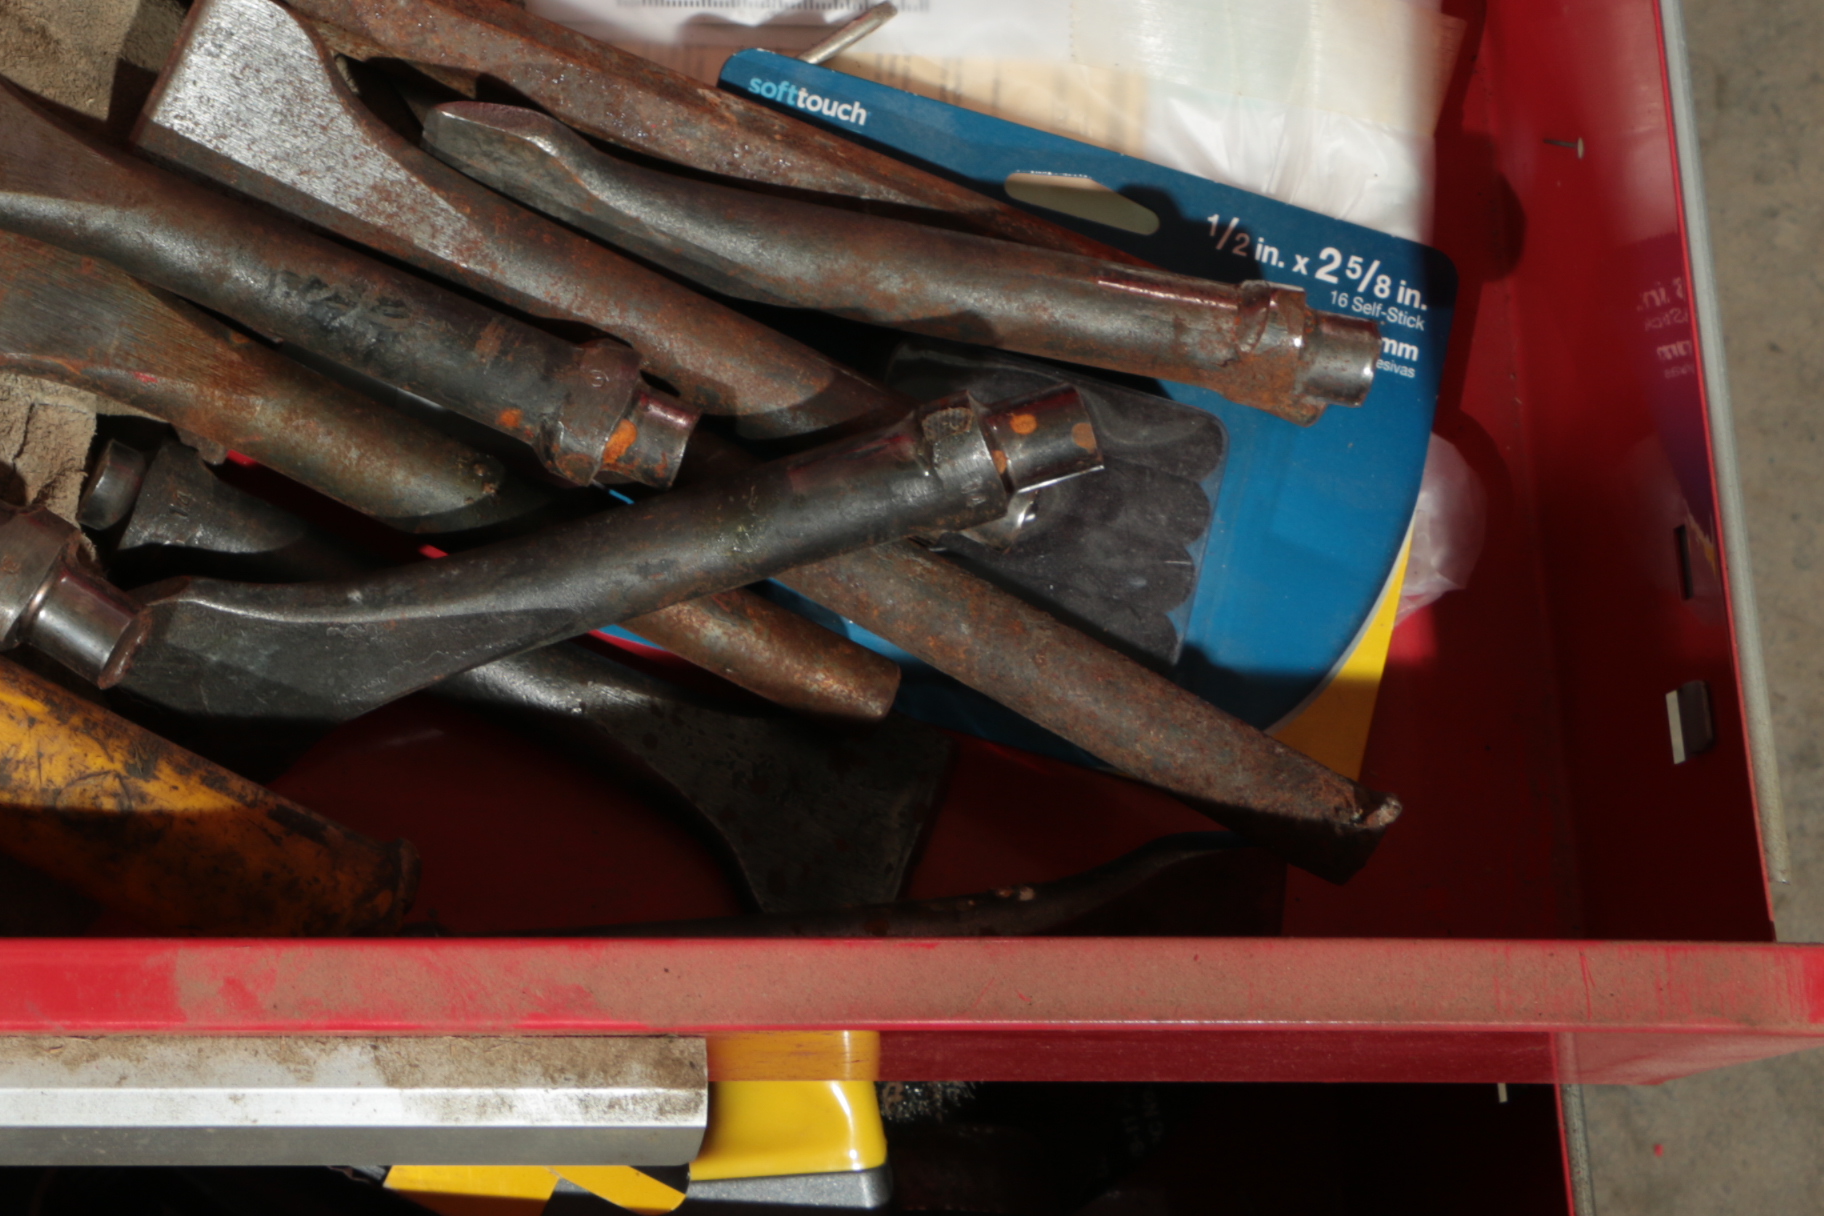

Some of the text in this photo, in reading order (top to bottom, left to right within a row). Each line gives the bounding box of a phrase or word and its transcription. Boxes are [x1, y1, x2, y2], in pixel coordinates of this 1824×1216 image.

[746, 72, 870, 126] softtouch
[1200, 210, 1256, 258] 1/2
[1252, 236, 1290, 269] in.
[1291, 254, 1312, 276] x
[1395, 280, 1433, 312] in.
[1328, 290, 1428, 331] 16 Self-Stick
[1375, 357, 1417, 379] esivas
